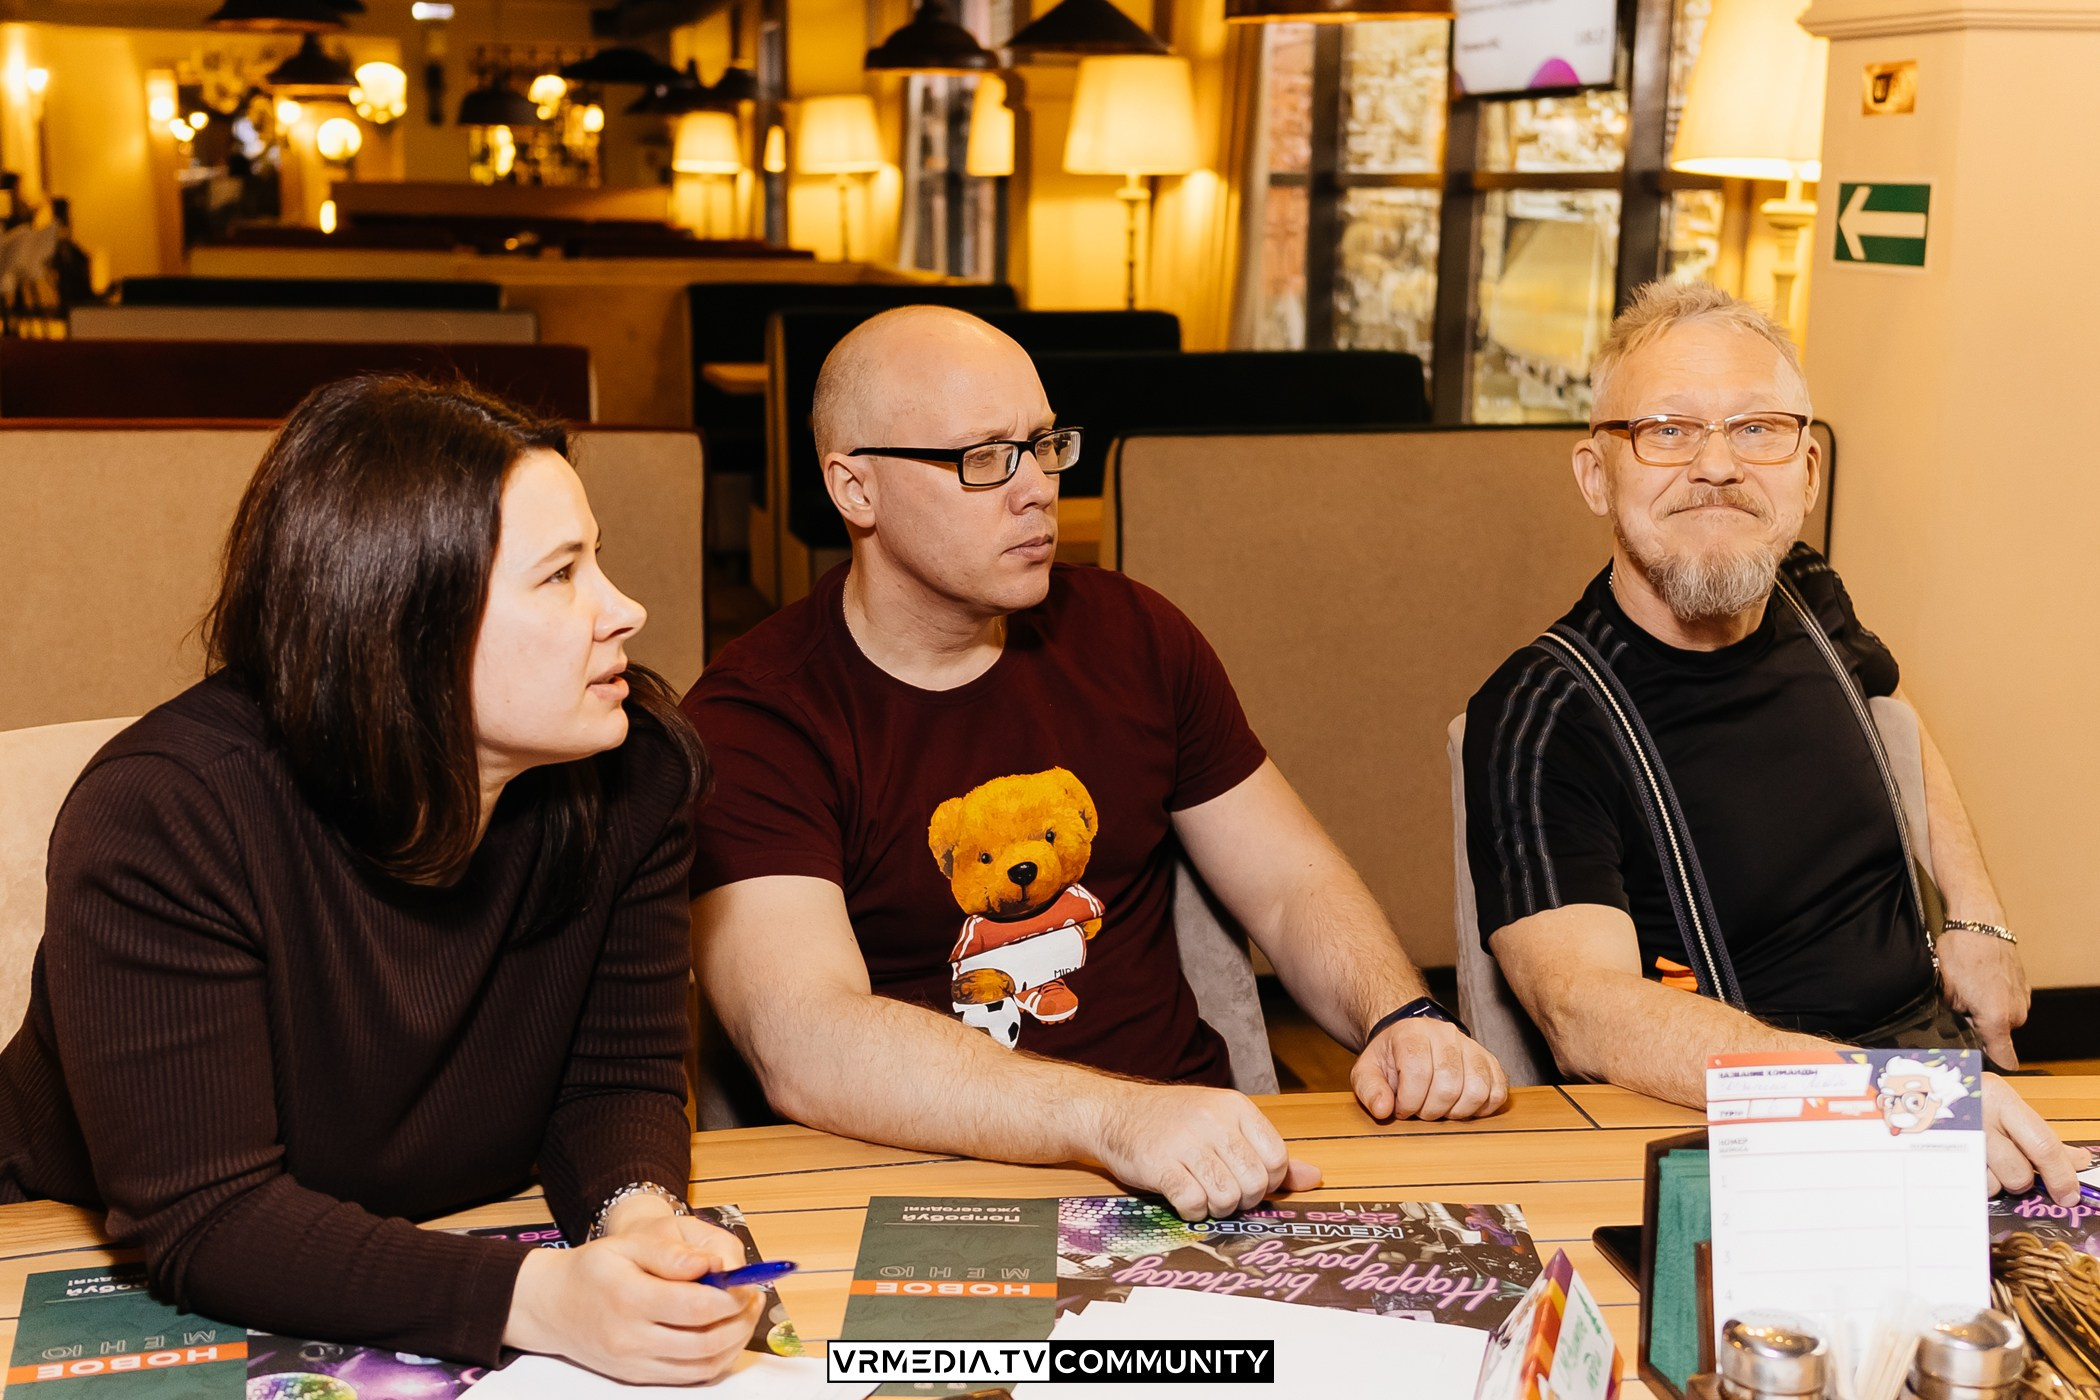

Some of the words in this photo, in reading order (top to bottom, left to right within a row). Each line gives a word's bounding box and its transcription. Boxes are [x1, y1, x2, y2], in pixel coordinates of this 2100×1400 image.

[902, 1213, 1021, 1224] Попробуй
[1306, 1211, 1400, 1223] 25-26
[2014, 1195, 2100, 1228] day
[1186, 1220, 1404, 1239] КЕМЕРОВО
[879, 1265, 1031, 1280] МЕНЮ
[1237, 1241, 1379, 1274] party
[874, 1282, 1032, 1296] НОВОЕ
[1111, 1255, 1319, 1302] birthday
[1341, 1262, 1499, 1312] Happy
[41, 1329, 216, 1361] МЕНЮ
[36, 1347, 218, 1380] НОВОЕ
